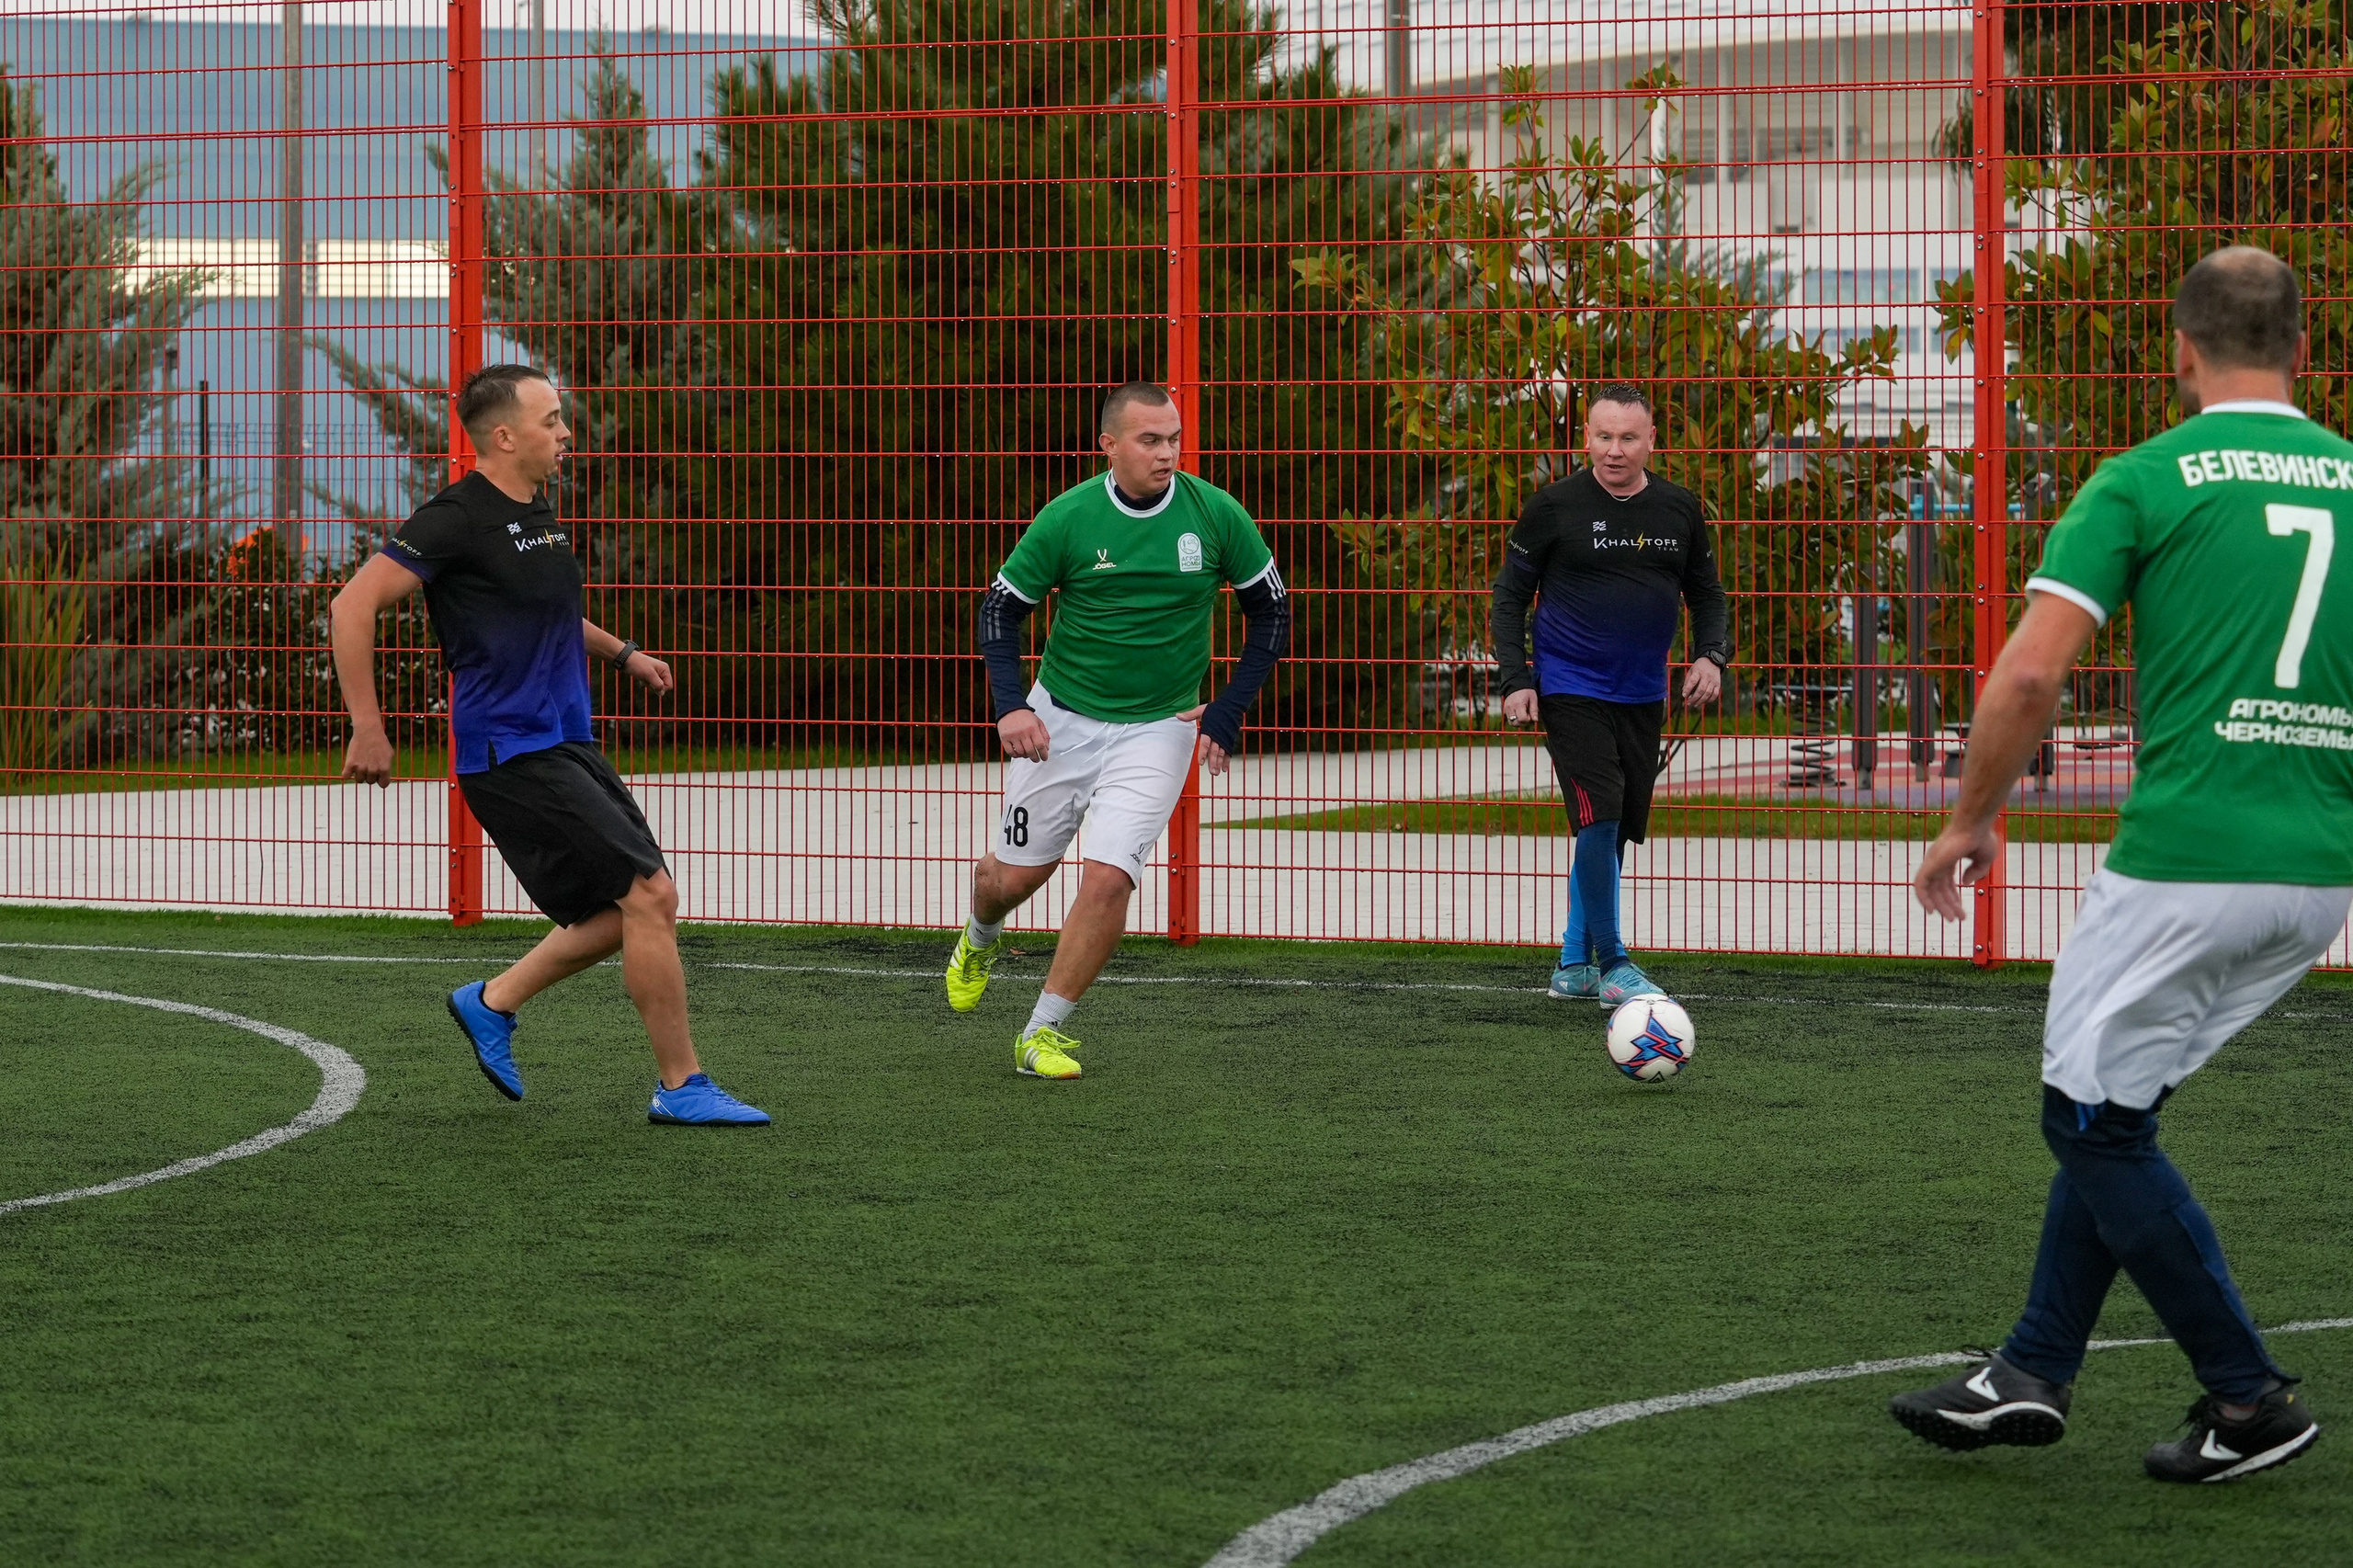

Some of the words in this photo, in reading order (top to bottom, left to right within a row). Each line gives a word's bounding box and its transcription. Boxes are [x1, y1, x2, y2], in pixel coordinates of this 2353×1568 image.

[2177, 449, 2353, 491] БЕЛЕВИНСК
[2265, 503, 2335, 689] 7
[2214, 721, 2353, 750] ЧЕРНОЗЕМЬ
[1004, 803, 1029, 847] 48
